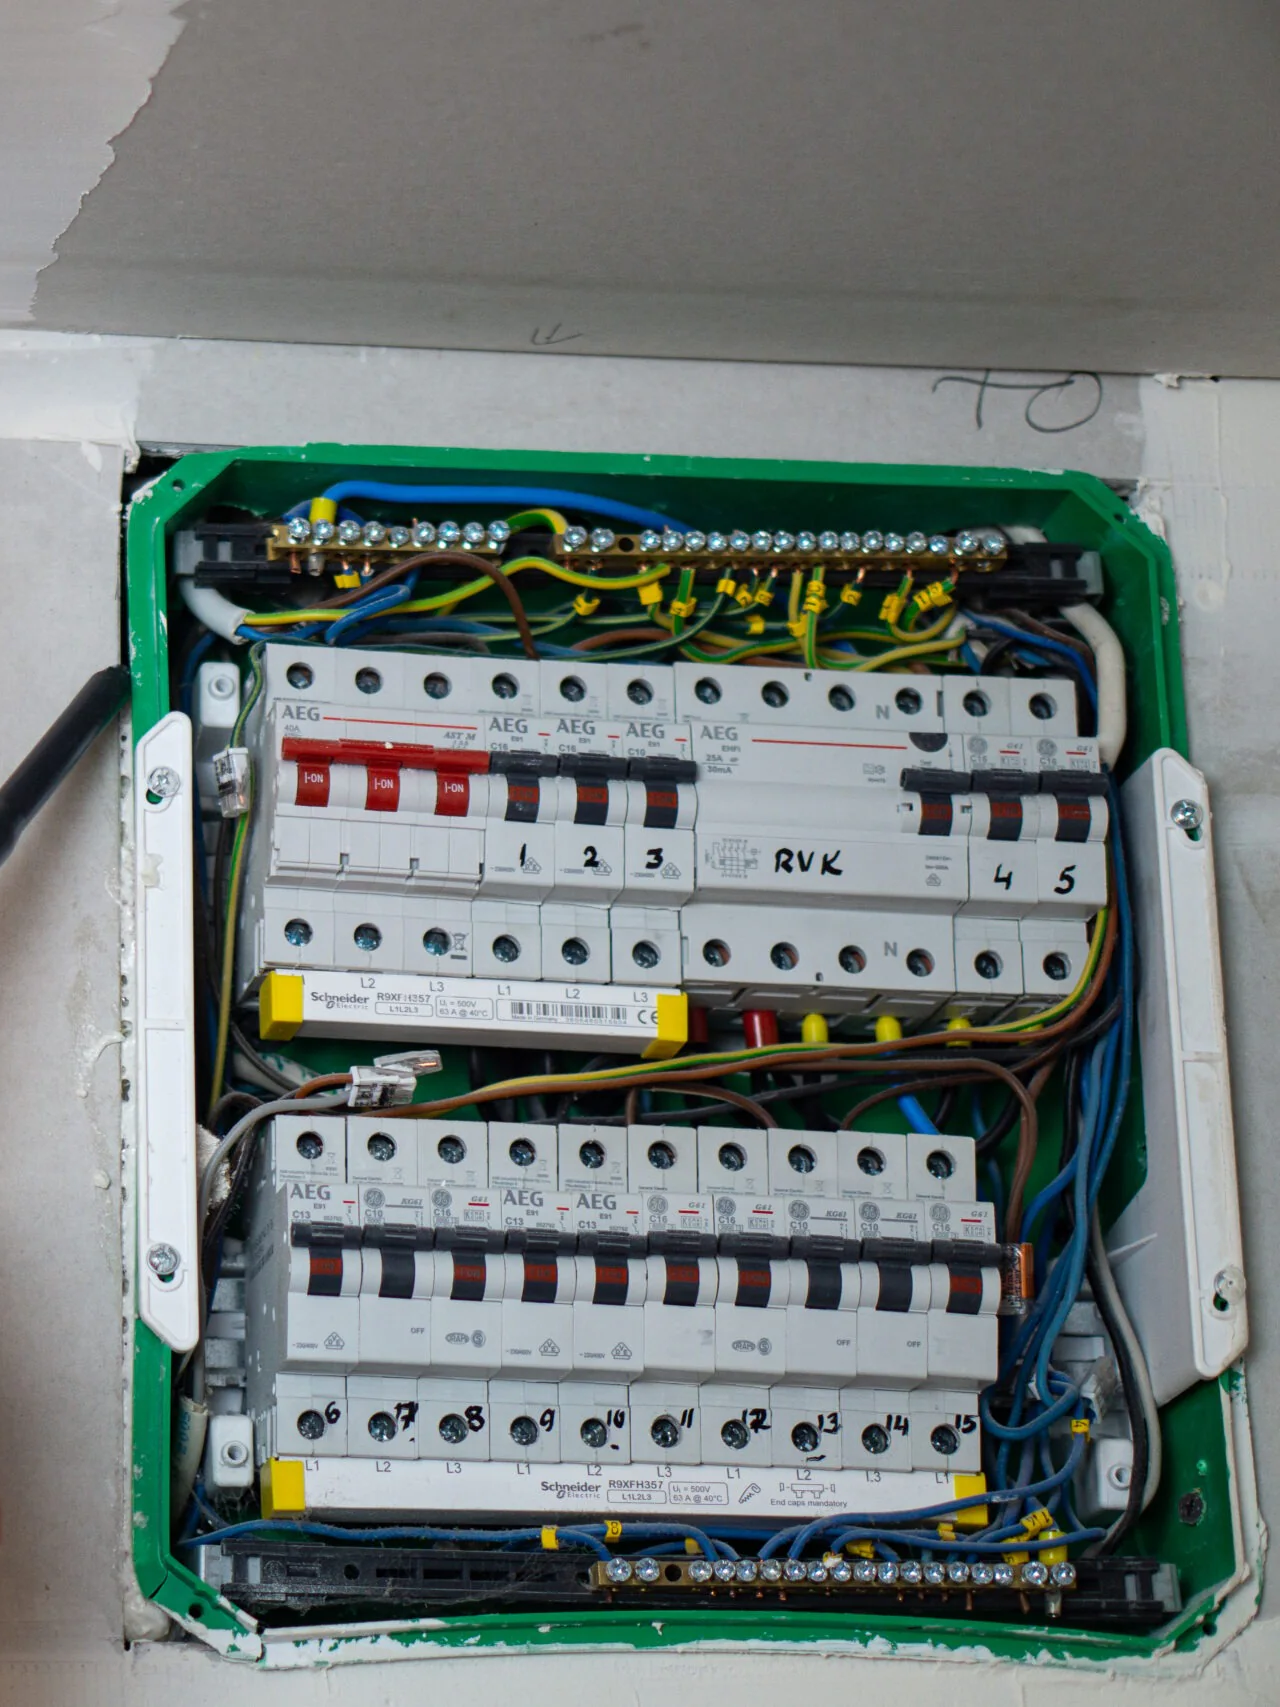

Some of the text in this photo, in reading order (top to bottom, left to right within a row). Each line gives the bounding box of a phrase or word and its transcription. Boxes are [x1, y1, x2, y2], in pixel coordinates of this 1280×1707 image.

[281, 705, 320, 722] AEG
[489, 717, 528, 734] AEG
[556, 719, 595, 736] AEG
[626, 722, 665, 740] AEG
[700, 725, 738, 741] AEG
[707, 765, 732, 774] 30mA
[520, 843, 527, 867] 1
[583, 845, 600, 868] 2
[645, 848, 663, 869] 3
[774, 847, 843, 876] RVK
[993, 863, 1013, 890] 4
[1054, 865, 1077, 895] 5
[883, 942, 898, 958] N
[311, 992, 369, 1004] Schneider
[361, 977, 648, 1003] L2 L3 L1 L2 L3
[290, 1184, 330, 1200] AEG
[503, 1190, 544, 1207] AEG
[576, 1193, 617, 1210] AEG
[292, 1210, 311, 1219] C13
[365, 1209, 383, 1217] C10
[434, 1208, 451, 1217] C16
[505, 1217, 524, 1226] C13
[578, 1220, 597, 1229] C13
[324, 1401, 341, 1424] 6
[464, 1405, 485, 1432] 8
[539, 1408, 556, 1432] 9
[607, 1408, 625, 1428] 10
[680, 1408, 694, 1428] 11
[817, 1412, 841, 1434] 13
[886, 1414, 909, 1436] 14
[955, 1414, 977, 1434] 15
[305, 1460, 949, 1484] L1 L2 L3 L1 L2 L3 L1 L2 L3 L1
[541, 1480, 663, 1493] Schneider R9XFH357
[690, 1485, 711, 1493] 500V
[622, 1493, 652, 1501] L1L2L3
[684, 1494, 691, 1502] A
[693, 1494, 701, 1502] @
[703, 1494, 723, 1502] 40°C
[770, 1499, 784, 1507] End
[808, 1500, 848, 1508] mandatory
